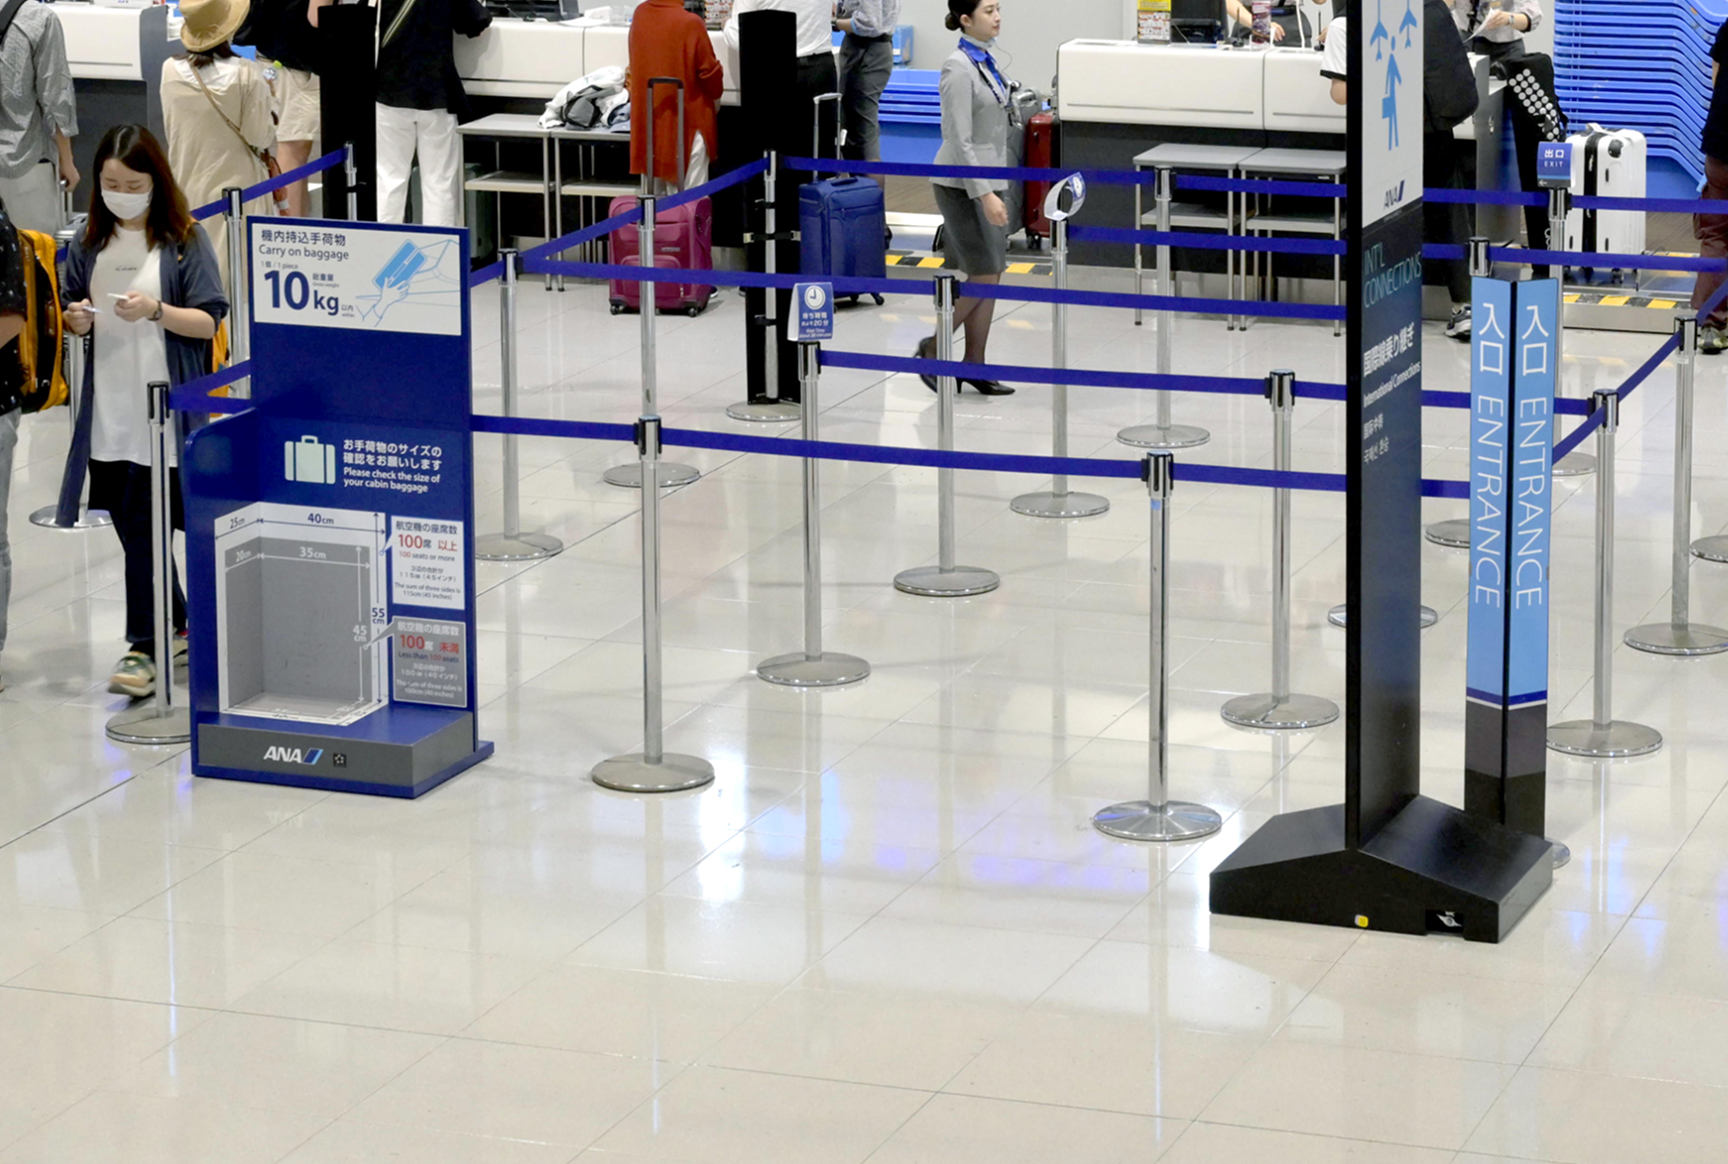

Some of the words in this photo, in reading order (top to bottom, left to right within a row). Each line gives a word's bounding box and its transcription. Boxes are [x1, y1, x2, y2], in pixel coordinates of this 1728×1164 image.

[1544, 149, 1564, 158] 出口
[261, 229, 346, 247] 機内持込手荷物
[259, 244, 286, 258] Carry
[288, 248, 302, 256] on
[304, 247, 349, 262] baggage
[1363, 251, 1422, 308] CONNECTIONS
[264, 270, 310, 311] 10
[314, 289, 339, 316] kg
[1478, 302, 1505, 376] 入口
[1521, 305, 1549, 377] 入口
[343, 439, 442, 457] お手荷物のサイズの
[343, 452, 442, 471] 確認をお願いします
[343, 467, 371, 478] Please
[372, 469, 397, 480] check
[397, 472, 412, 481] the
[413, 473, 430, 483] size
[431, 474, 441, 483] of
[343, 478, 363, 487] your
[365, 479, 389, 489] cabin
[390, 481, 428, 494] baggage
[1475, 394, 1504, 609] ENTRANCE
[1516, 397, 1547, 610] ENTRANCE
[230, 517, 245, 529] 25cm
[307, 513, 334, 525] 40cm
[396, 521, 457, 535] 航空機の座席数
[299, 547, 327, 559] 35cm
[438, 540, 457, 552] 以上
[371, 607, 385, 618] 55
[353, 624, 367, 635] 45
[263, 746, 302, 764] ANA
